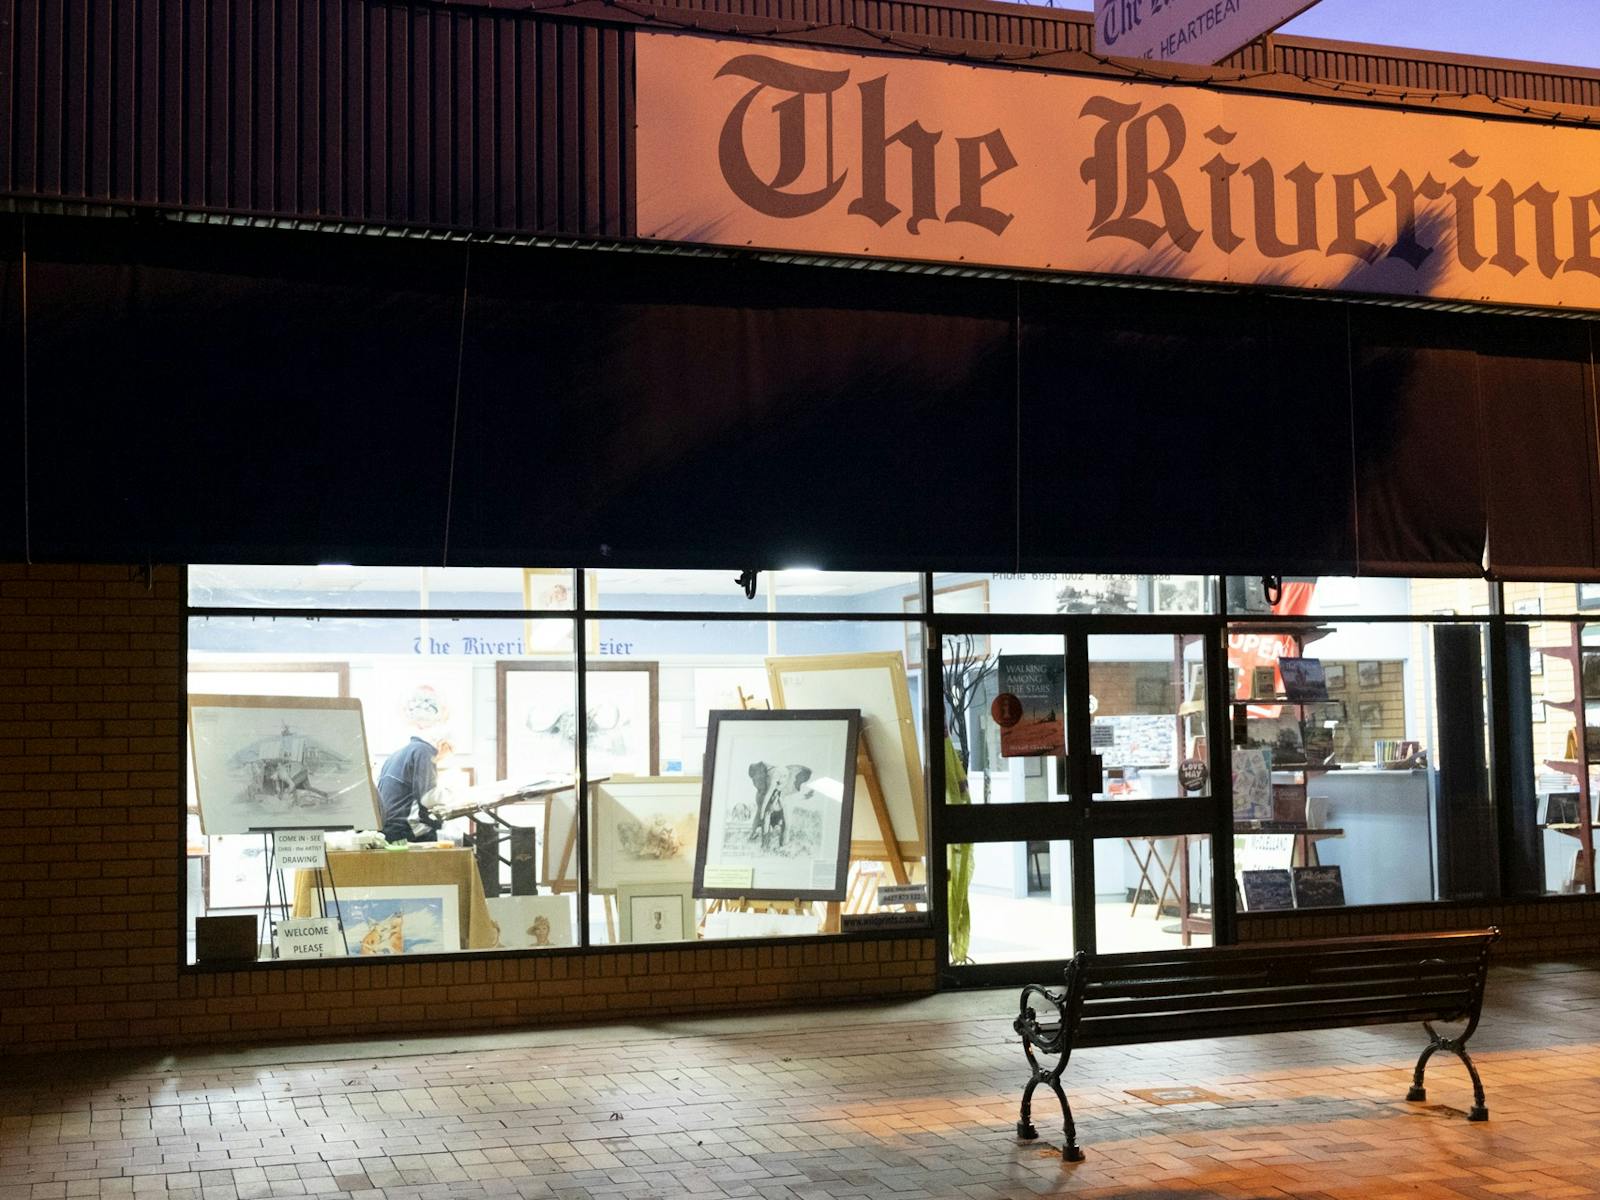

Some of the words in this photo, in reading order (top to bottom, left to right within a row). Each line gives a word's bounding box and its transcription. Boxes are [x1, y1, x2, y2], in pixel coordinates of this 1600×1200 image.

[713, 54, 1020, 236] The
[462, 636, 525, 656] Riveri
[600, 637, 634, 656] zier
[1006, 664, 1048, 673] WALKING
[1007, 674, 1042, 683] AMONG
[1008, 685, 1023, 694] THE
[1026, 684, 1050, 693] STARS
[1182, 762, 1204, 770] LOVE
[310, 834, 321, 842] SEE
[282, 855, 318, 864] DRAWING
[284, 926, 329, 938] WELCOME
[293, 944, 324, 954] PLEASE
